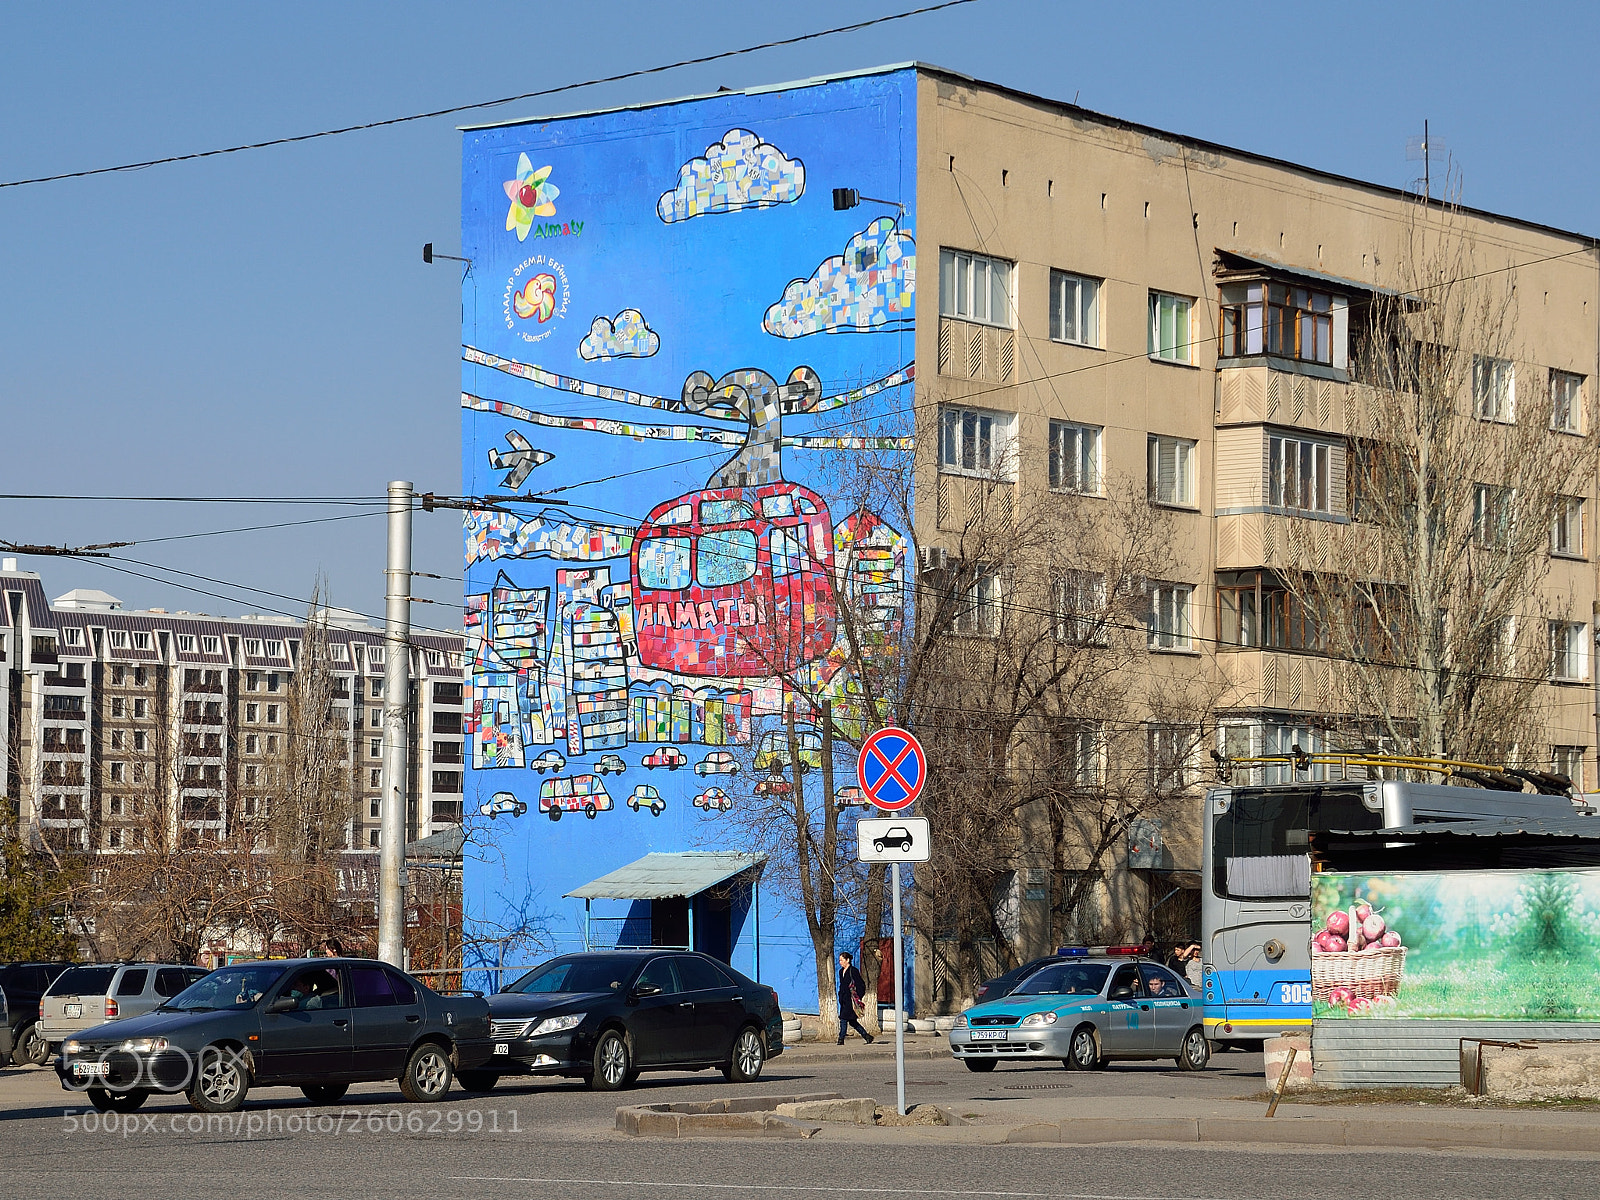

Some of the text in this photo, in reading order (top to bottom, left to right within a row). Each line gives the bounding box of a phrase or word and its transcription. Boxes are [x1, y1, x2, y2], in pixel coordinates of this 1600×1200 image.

[534, 219, 584, 240] Almaty
[636, 596, 767, 632] АЛМАТЫ
[1281, 984, 1313, 1004] 305
